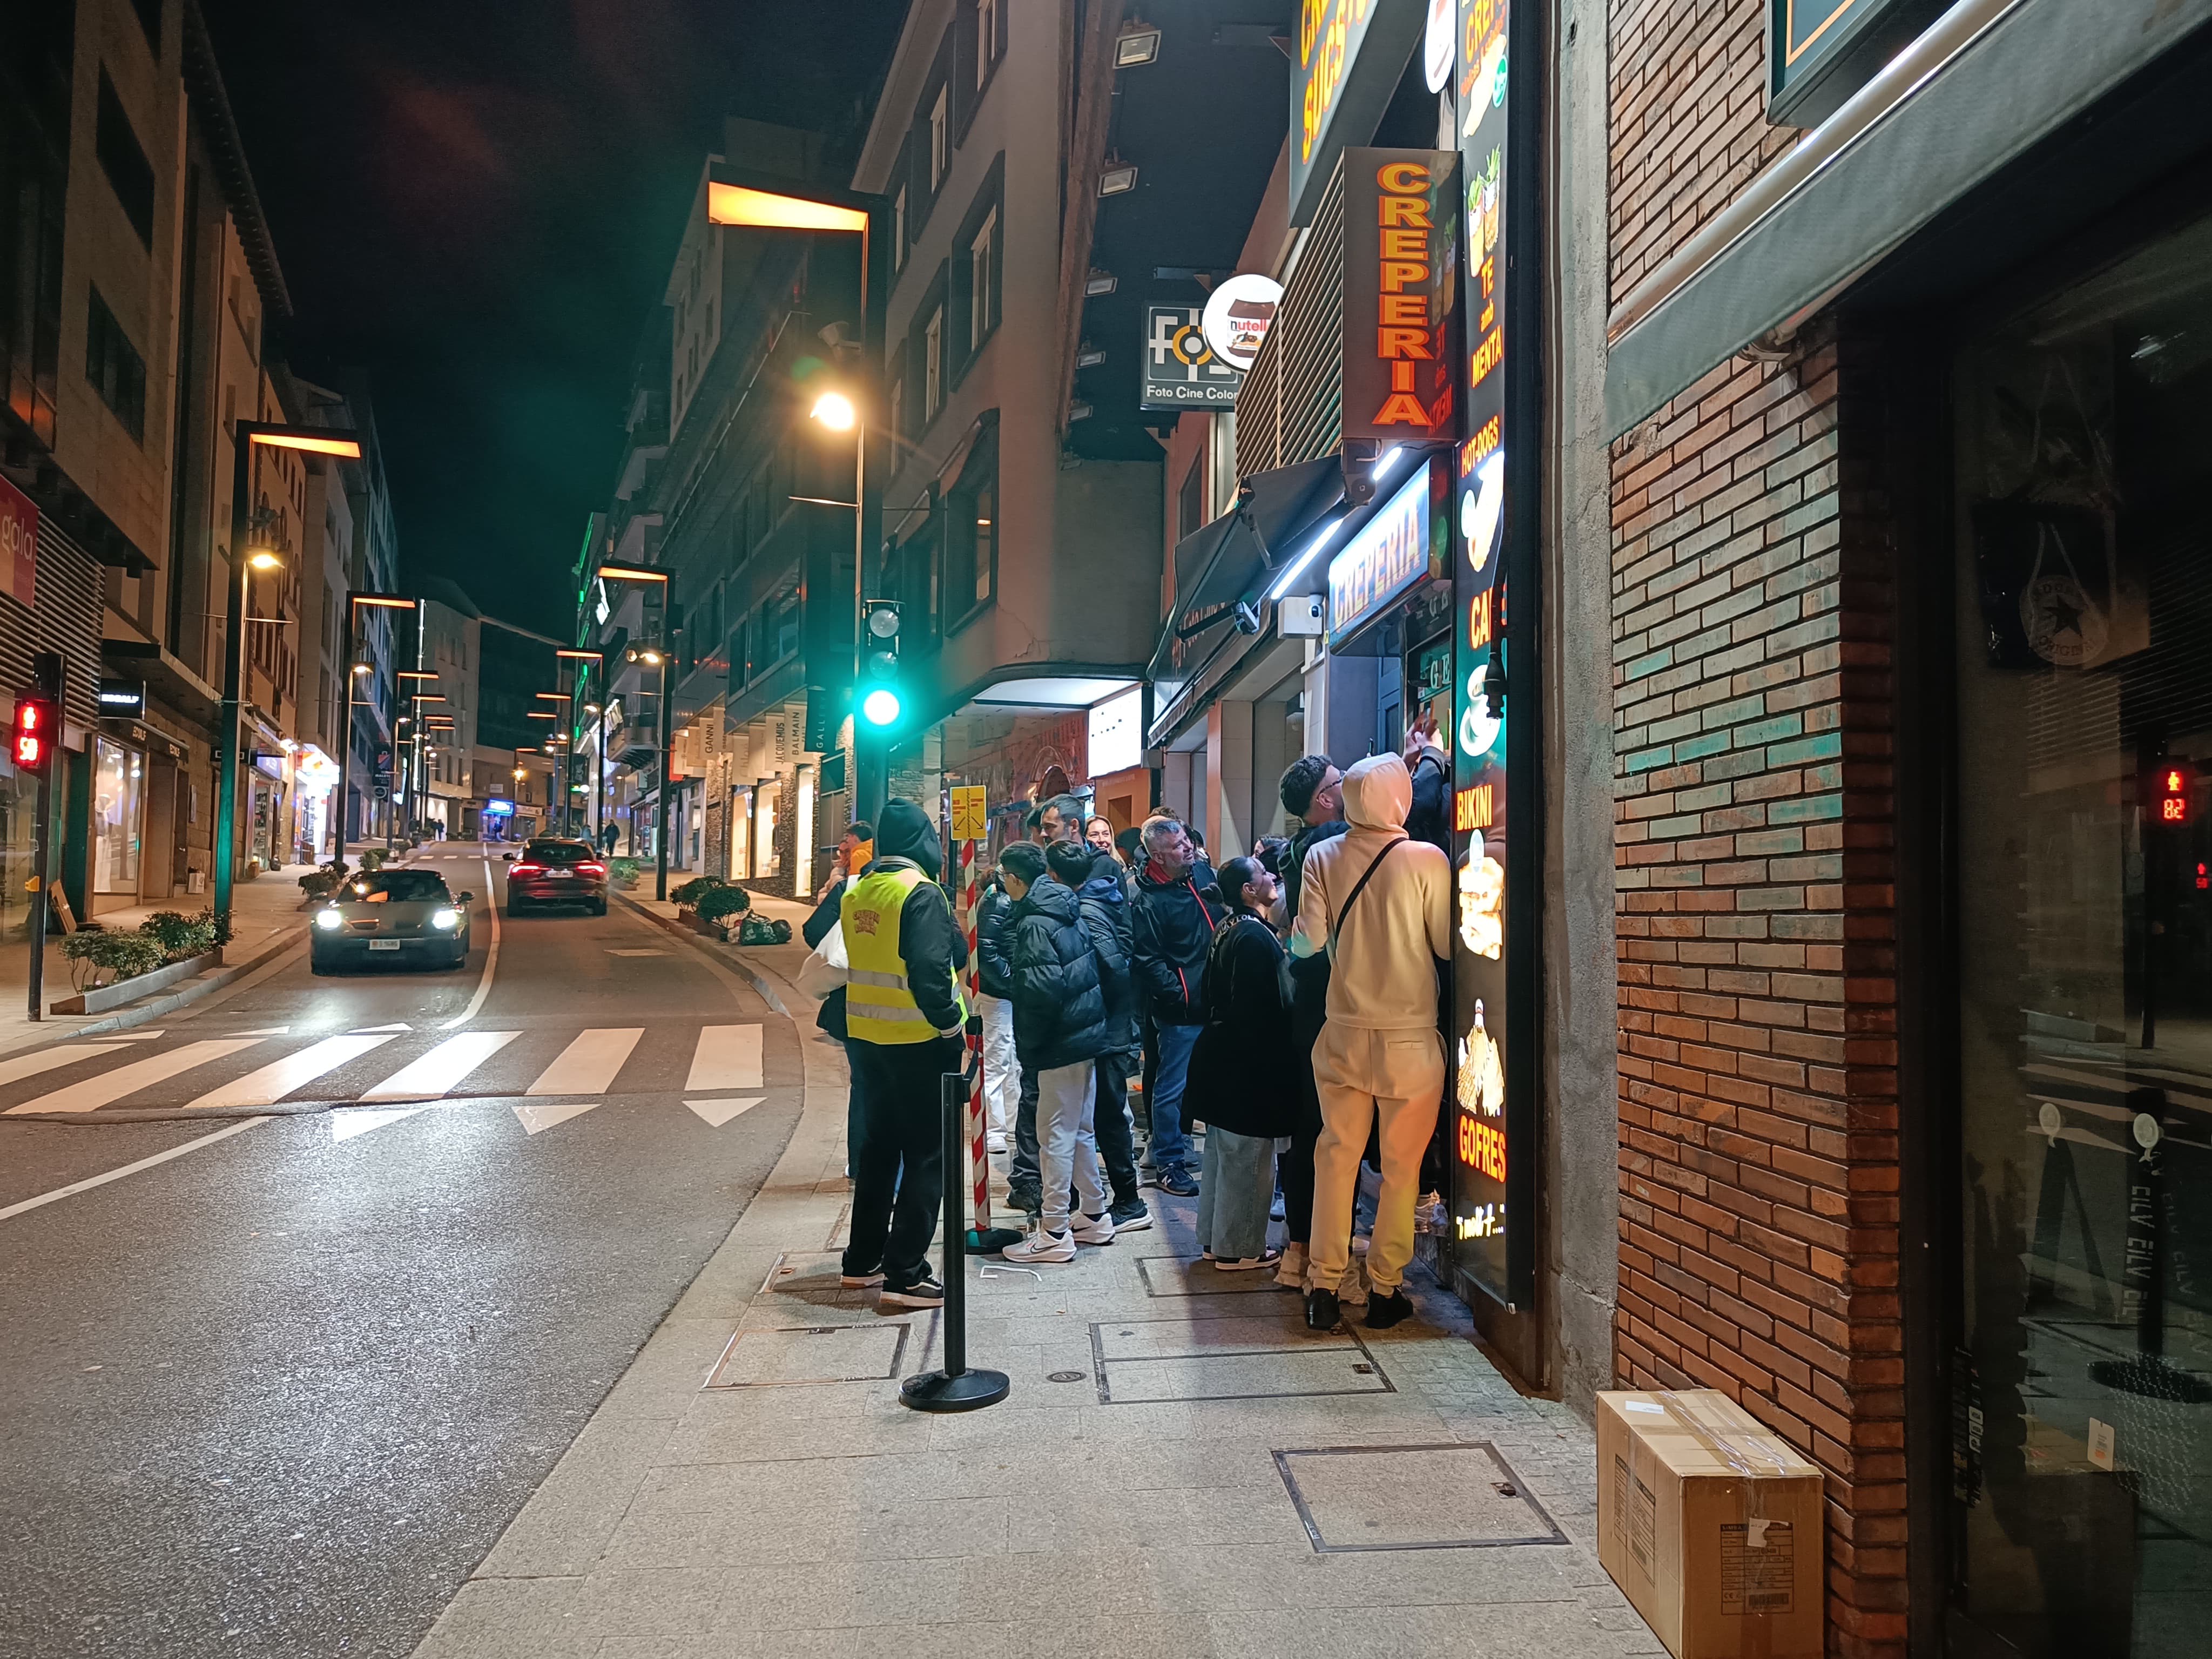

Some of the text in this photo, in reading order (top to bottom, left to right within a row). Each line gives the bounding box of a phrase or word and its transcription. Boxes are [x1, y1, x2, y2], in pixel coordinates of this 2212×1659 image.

[1372, 163, 1434, 426] CREPERIA
[1481, 255, 1494, 299] TE
[1231, 319, 1269, 332] nutell
[1472, 325, 1503, 388] MENTA
[1147, 385, 1238, 400] Foto Cine Color
[1461, 415, 1499, 478] HOT-DOGS
[2, 515, 33, 562] gala
[705, 724, 714, 754] GANNI
[775, 723, 785, 765] JACQUEMUS
[792, 712, 800, 755] BALMAIN
[1456, 784, 1493, 831] BIKINI
[1459, 1114, 1507, 1183] GOFRES
